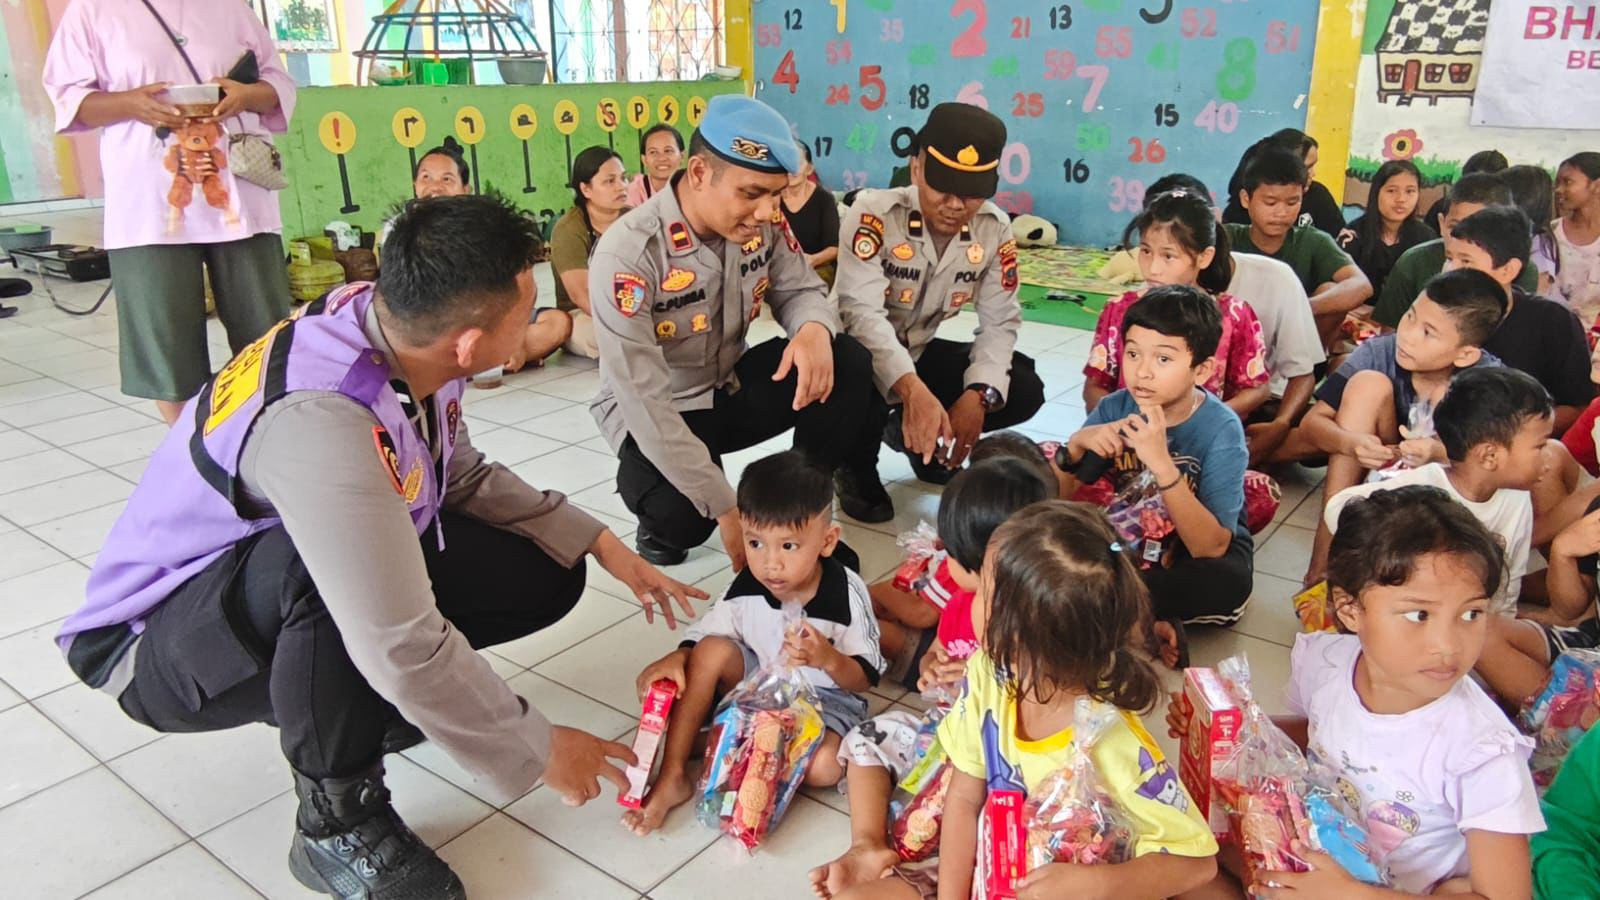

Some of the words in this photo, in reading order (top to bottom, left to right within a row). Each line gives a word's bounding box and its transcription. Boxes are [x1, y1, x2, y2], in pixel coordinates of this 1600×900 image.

[784, 9, 802, 30] 12
[951, 0, 987, 57] 2
[1011, 17, 1031, 38] 21
[1049, 5, 1072, 30] 13
[1180, 8, 1217, 39] 52
[1524, 6, 1600, 40] BH
[772, 50, 799, 93] 4
[1217, 37, 1257, 100] 8
[825, 84, 850, 105] 24
[859, 65, 886, 110] 5
[909, 84, 930, 110] 18
[1076, 65, 1110, 113] 7
[635, 103, 644, 122] P
[1012, 92, 1044, 117] 25
[1154, 103, 1180, 127] 15
[1194, 100, 1239, 133] 40
[814, 137, 832, 157] 17
[1128, 137, 1166, 164] 26
[1063, 158, 1090, 184] 16
